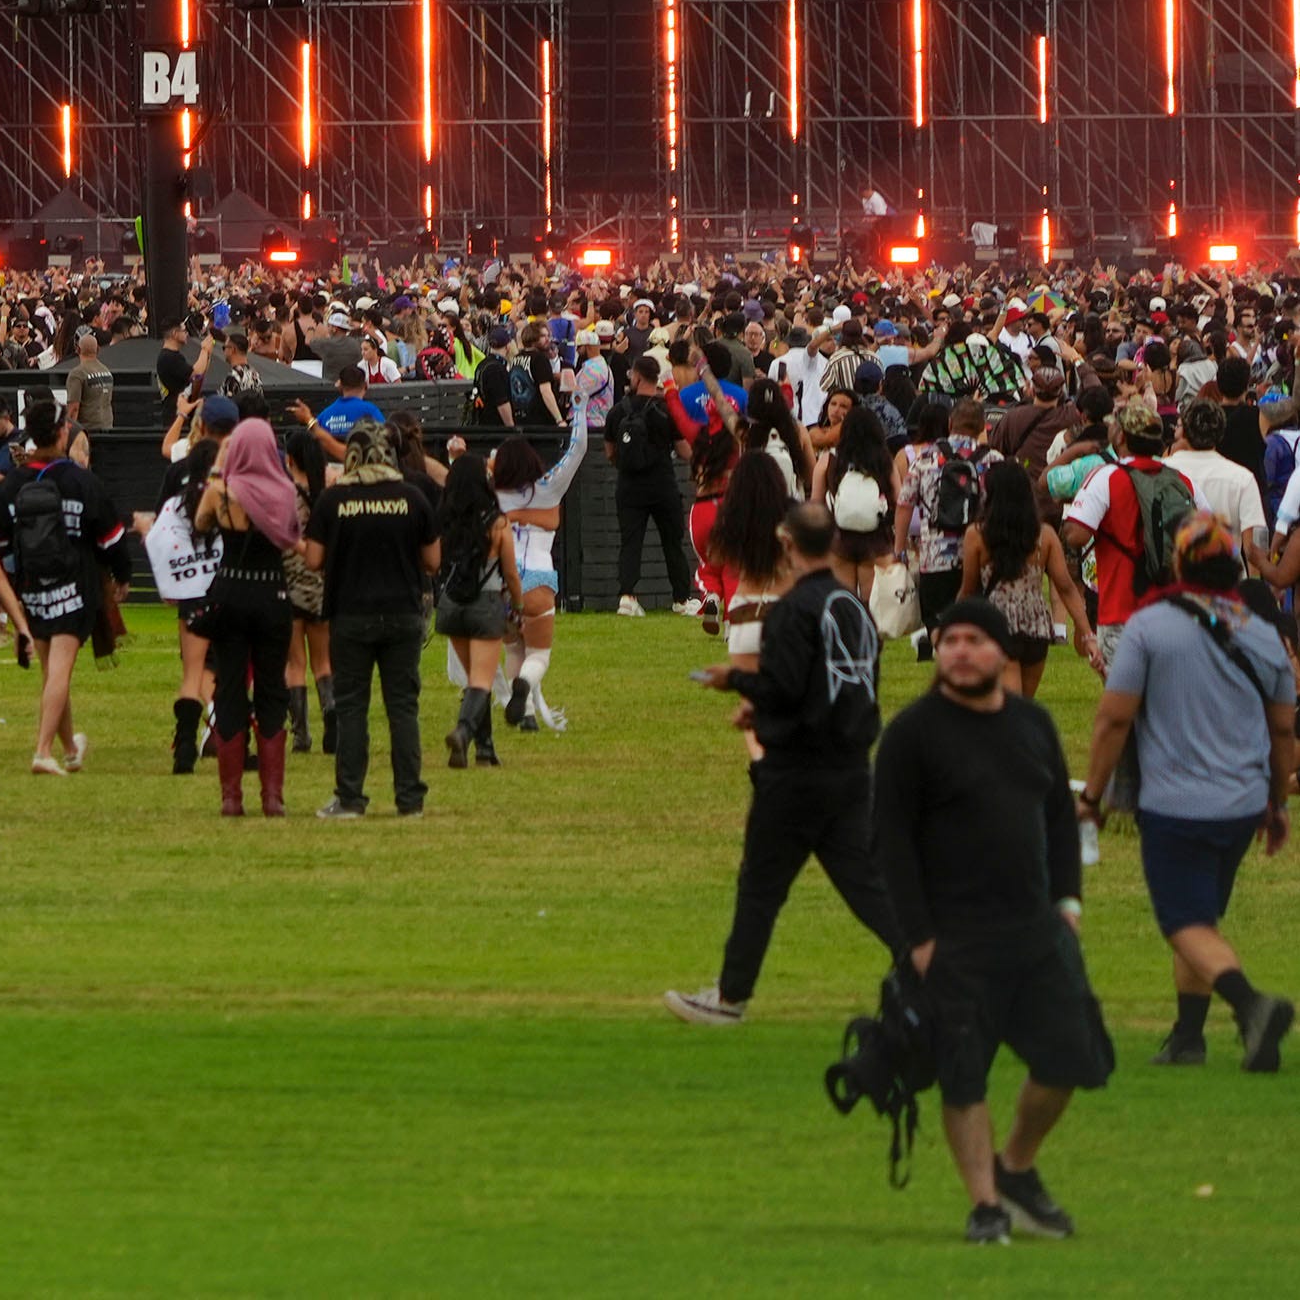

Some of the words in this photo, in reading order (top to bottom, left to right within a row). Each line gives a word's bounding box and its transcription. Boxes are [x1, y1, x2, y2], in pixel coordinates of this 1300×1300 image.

[143, 51, 200, 104] B4
[365, 497, 409, 515] НАХУЙ
[170, 567, 197, 582] TO
